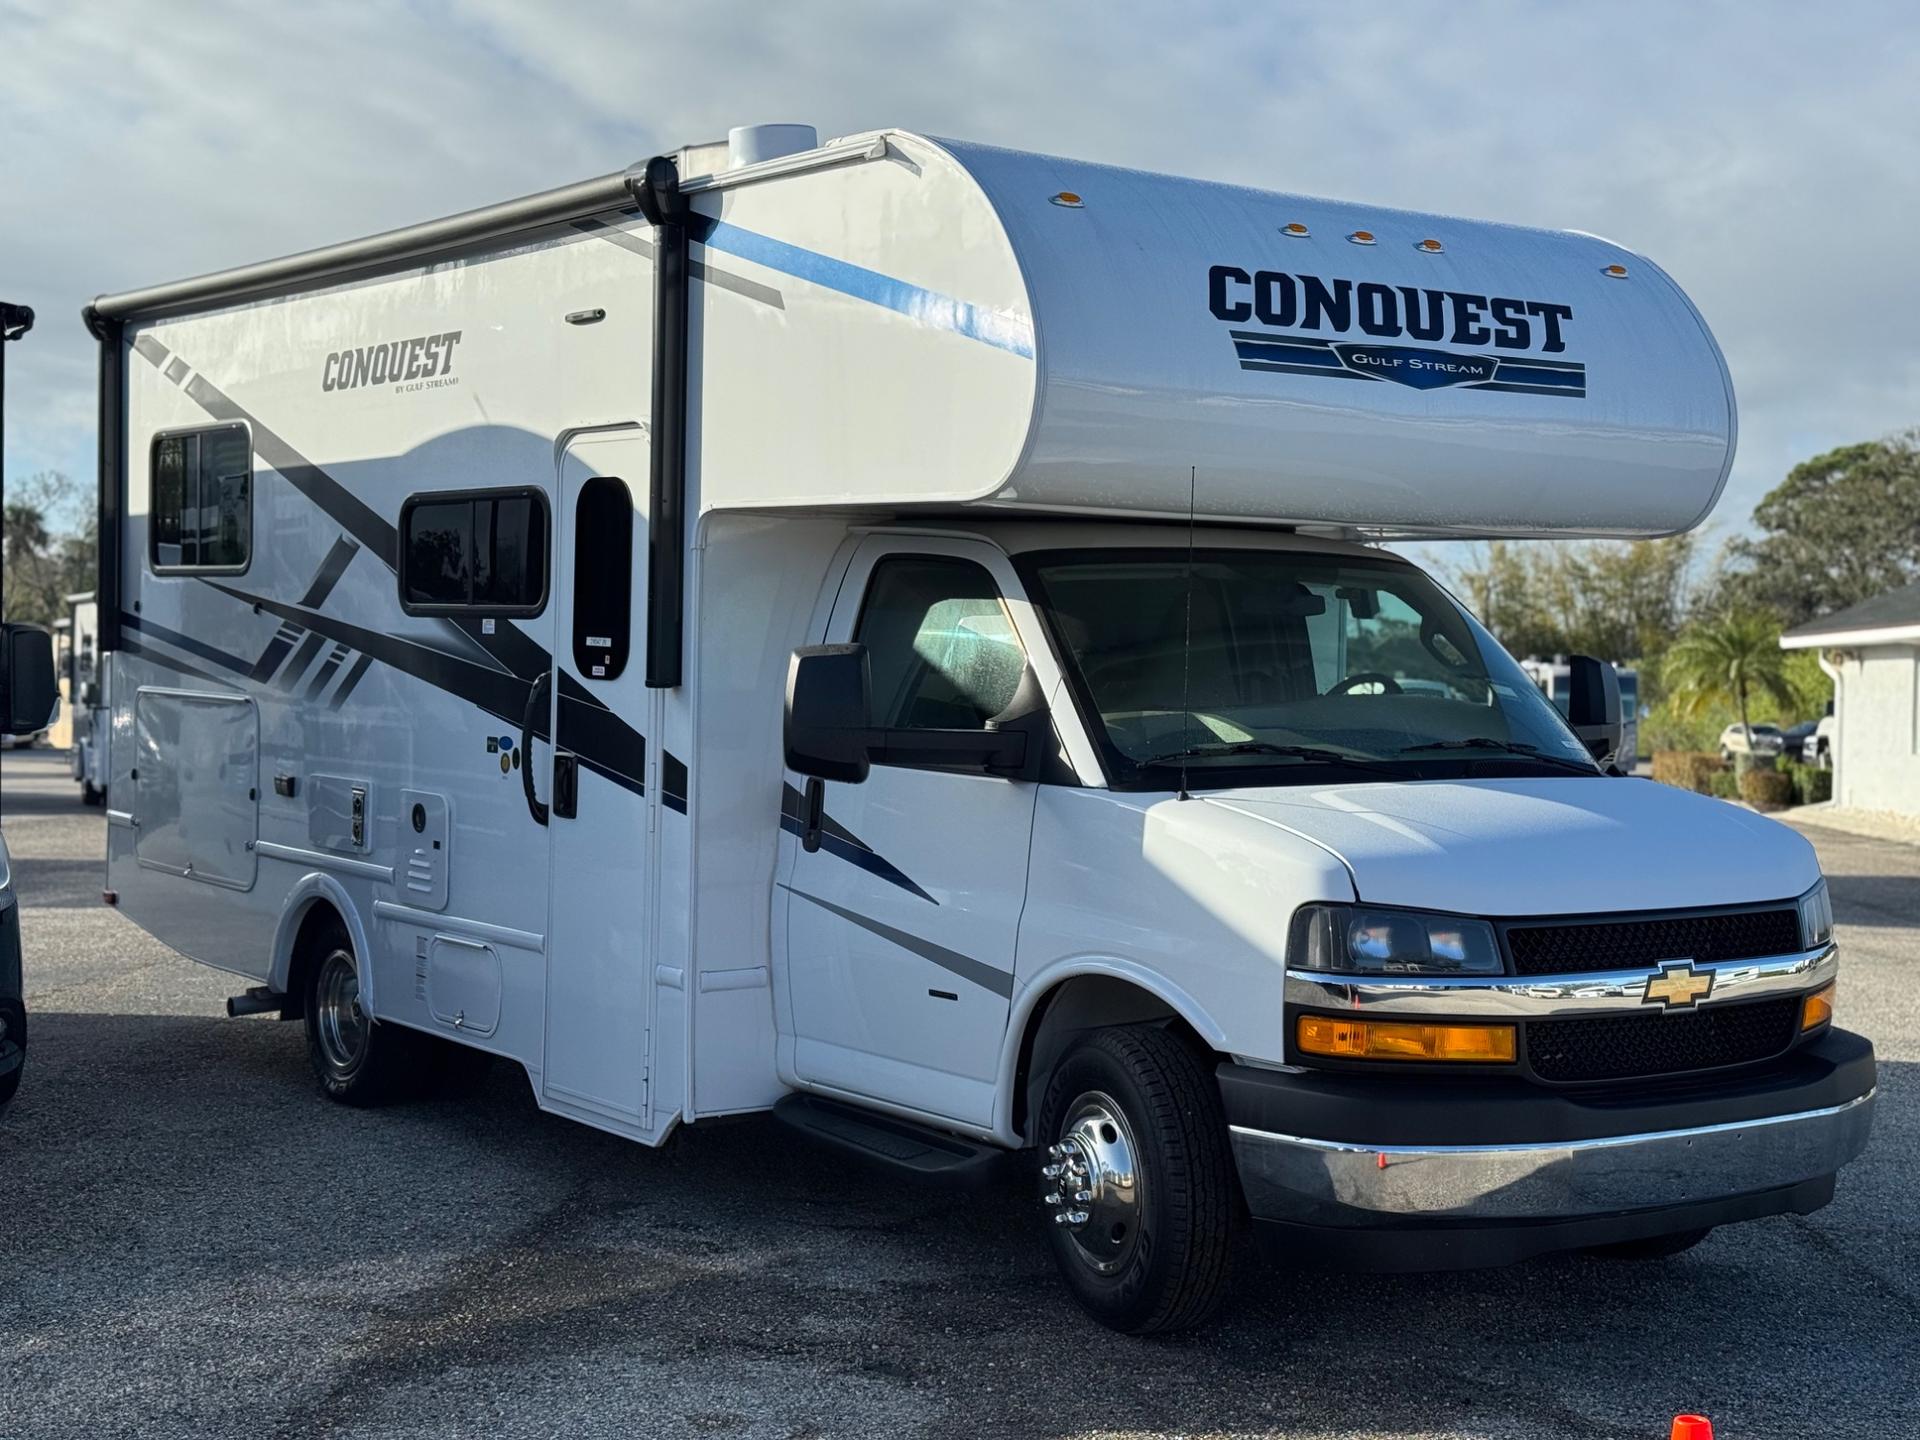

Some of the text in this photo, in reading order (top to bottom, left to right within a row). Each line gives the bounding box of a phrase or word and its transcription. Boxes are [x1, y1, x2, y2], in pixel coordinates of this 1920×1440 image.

[1209, 265, 1573, 353] CONQUEST
[322, 330, 462, 392] CONQUEST
[1351, 353, 1484, 375] GULF STREAM
[395, 385, 404, 394] BY
[406, 382, 423, 392] GULF
